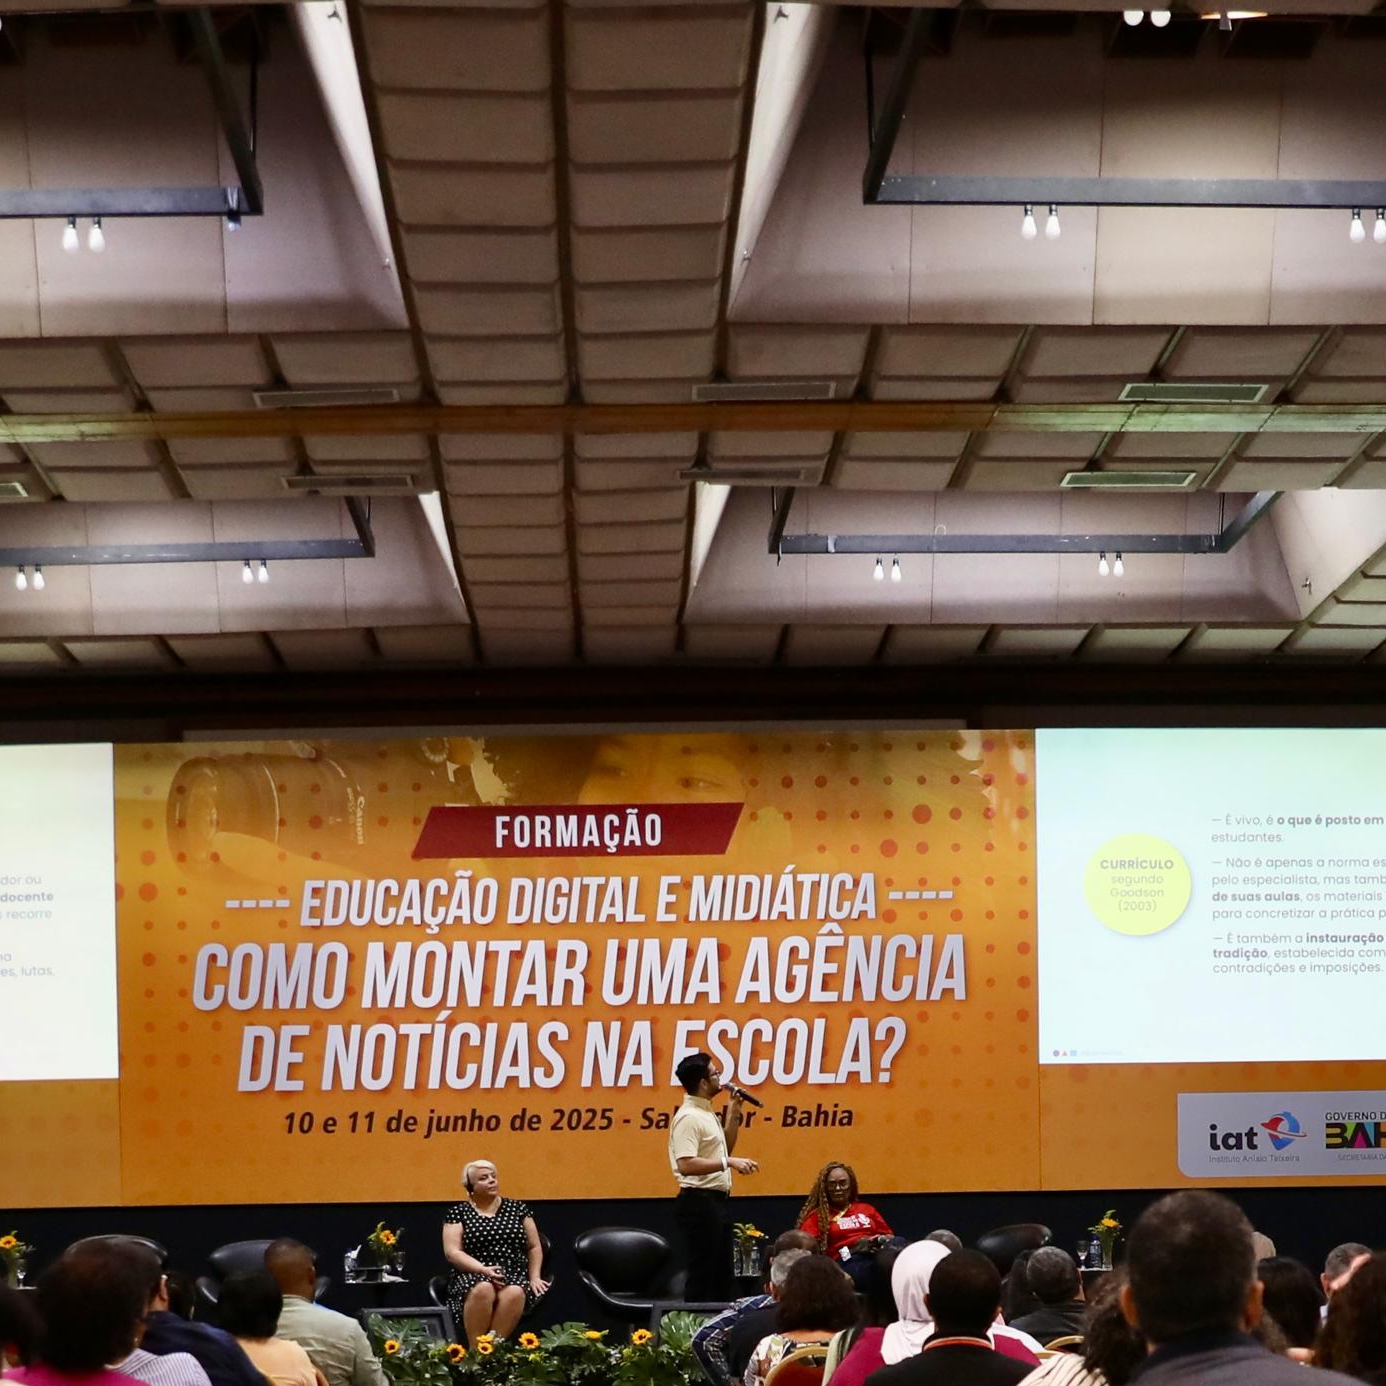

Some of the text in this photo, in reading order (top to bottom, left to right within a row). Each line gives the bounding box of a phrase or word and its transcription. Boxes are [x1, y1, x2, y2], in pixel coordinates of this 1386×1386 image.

[1226, 813, 1231, 825] É
[1266, 815, 1273, 826] é
[1277, 817, 1285, 825] o
[1288, 817, 1312, 828] que
[1315, 814, 1322, 825] é
[1325, 816, 1361, 828] posto
[1364, 817, 1384, 825] em
[495, 808, 662, 853] FORMAÇÃO
[1100, 857, 1174, 870] CURRÍCULO
[1226, 858, 1251, 868] Não
[1254, 858, 1262, 868] é
[1266, 859, 1313, 870] apenas
[1316, 859, 1325, 867] a
[1328, 859, 1369, 867] norma
[1110, 874, 1164, 886] segundo
[1212, 874, 1239, 887] pelo
[1323, 876, 1350, 885] mas
[0, 892, 53, 902] docente
[300, 864, 876, 934] EDUCAÇÃO DIGITAL E MIDIÁTICA
[1110, 888, 1164, 897] Goodson
[1212, 891, 1228, 901] de
[1306, 893, 1320, 902] os
[1324, 891, 1382, 901] materiais
[1118, 899, 1157, 912] (2003)
[1213, 910, 1242, 921] para
[1245, 908, 1315, 919] concretizar
[1319, 910, 1327, 918] a
[1331, 908, 1374, 921] prática
[1227, 932, 1233, 944] É
[1237, 934, 1291, 944] também
[1295, 935, 1303, 943] a
[1306, 933, 1384, 945] instauração
[1274, 947, 1354, 958] estabelecida
[192, 922, 966, 1011] COMO MONTAR UMA AGÊNCIA
[1213, 962, 1295, 976] contradições
[1299, 964, 1306, 973] e
[237, 1010, 908, 1092] DE NOTÍCIAS NA ESCOLA?
[284, 1111, 314, 1134] 10
[323, 1116, 337, 1134] e
[349, 1110, 375, 1133] 11
[386, 1109, 418, 1133] de
[424, 1108, 501, 1138] junho
[509, 1108, 542, 1132] de
[550, 1107, 613, 1131] 2025
[781, 1104, 853, 1128] Bahia
[1325, 1111, 1376, 1121] GOVERNO
[1209, 1123, 1258, 1151] iat
